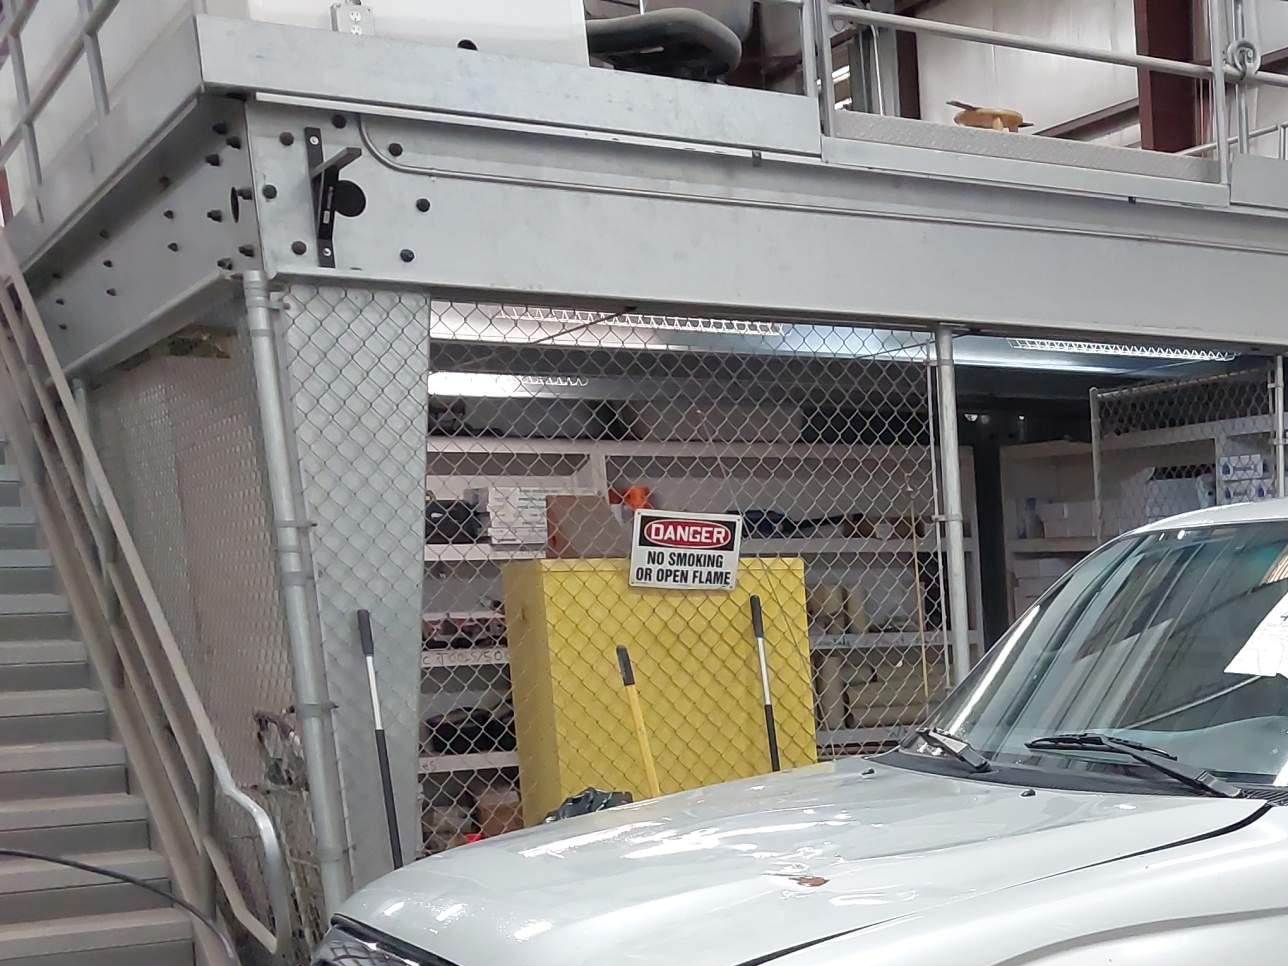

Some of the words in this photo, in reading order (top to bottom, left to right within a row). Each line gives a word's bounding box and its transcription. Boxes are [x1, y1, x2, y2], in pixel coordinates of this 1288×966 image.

[651, 523, 726, 543] DANGER
[647, 551, 665, 565] NO
[668, 552, 724, 568] SMOKING
[636, 567, 653, 581] OR
[656, 569, 689, 583] OPEN
[692, 570, 731, 585] FLAME
